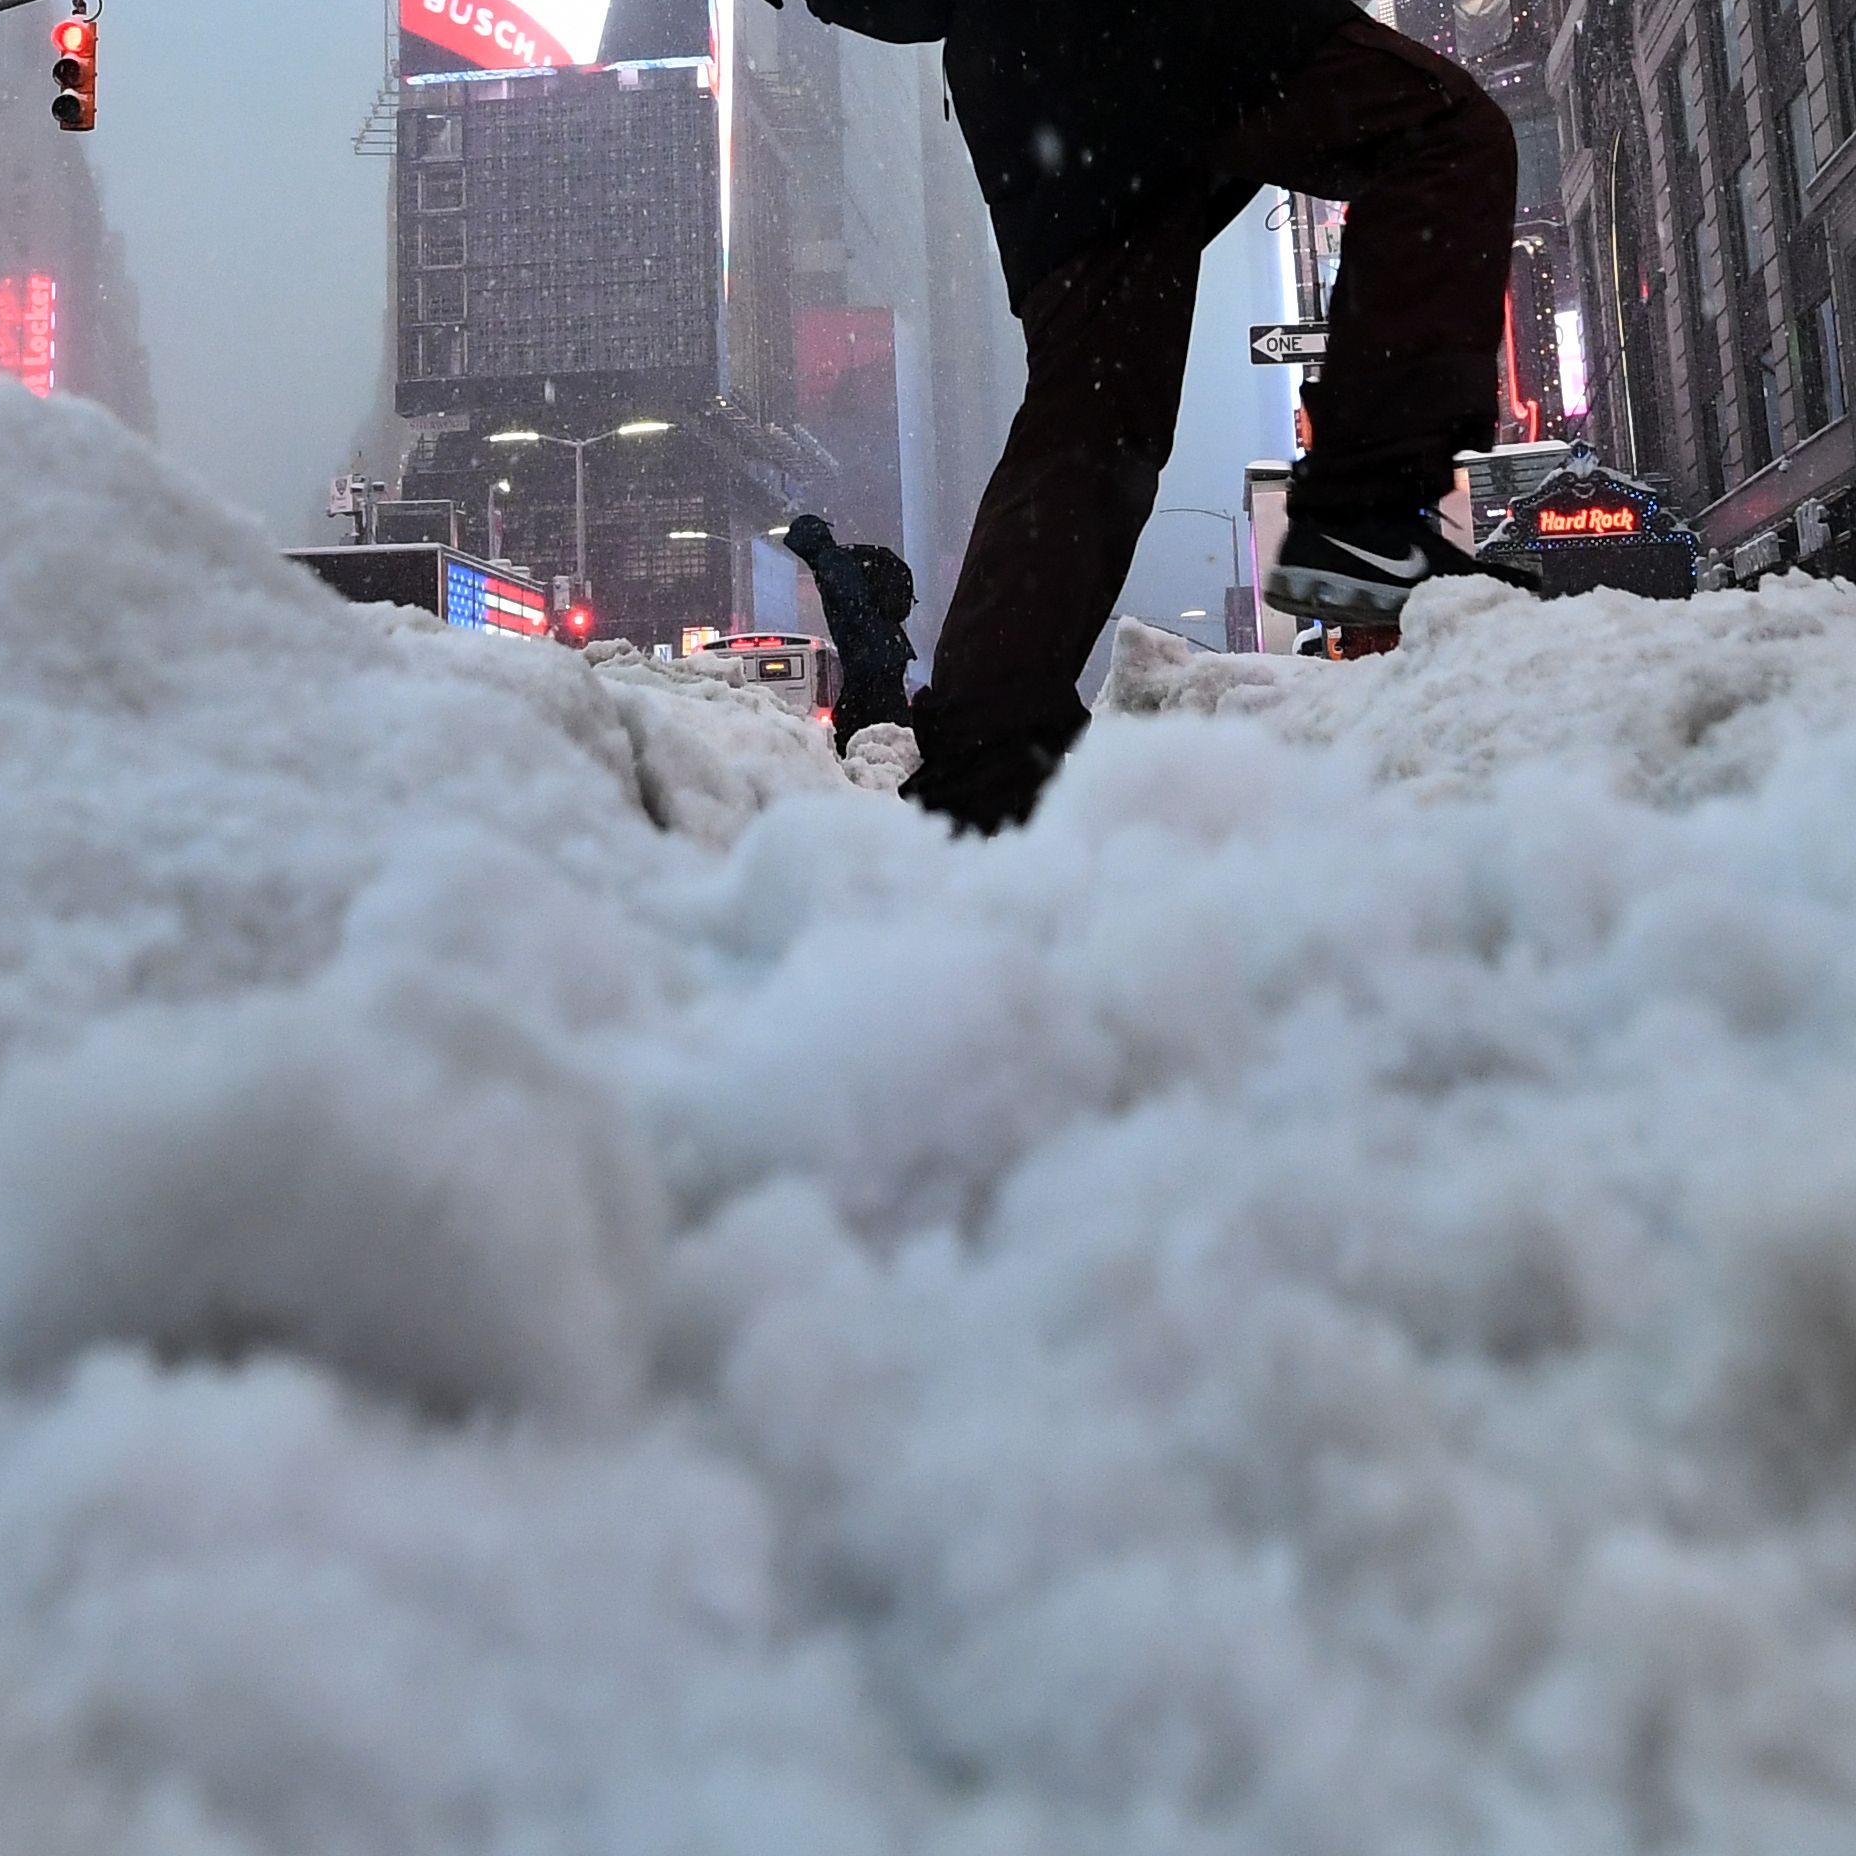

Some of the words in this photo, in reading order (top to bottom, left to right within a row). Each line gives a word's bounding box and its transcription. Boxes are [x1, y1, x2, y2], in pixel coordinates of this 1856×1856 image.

[1266, 336, 1303, 352] ONE
[1539, 509, 1587, 532] Hard
[1589, 506, 1635, 533] Rock
